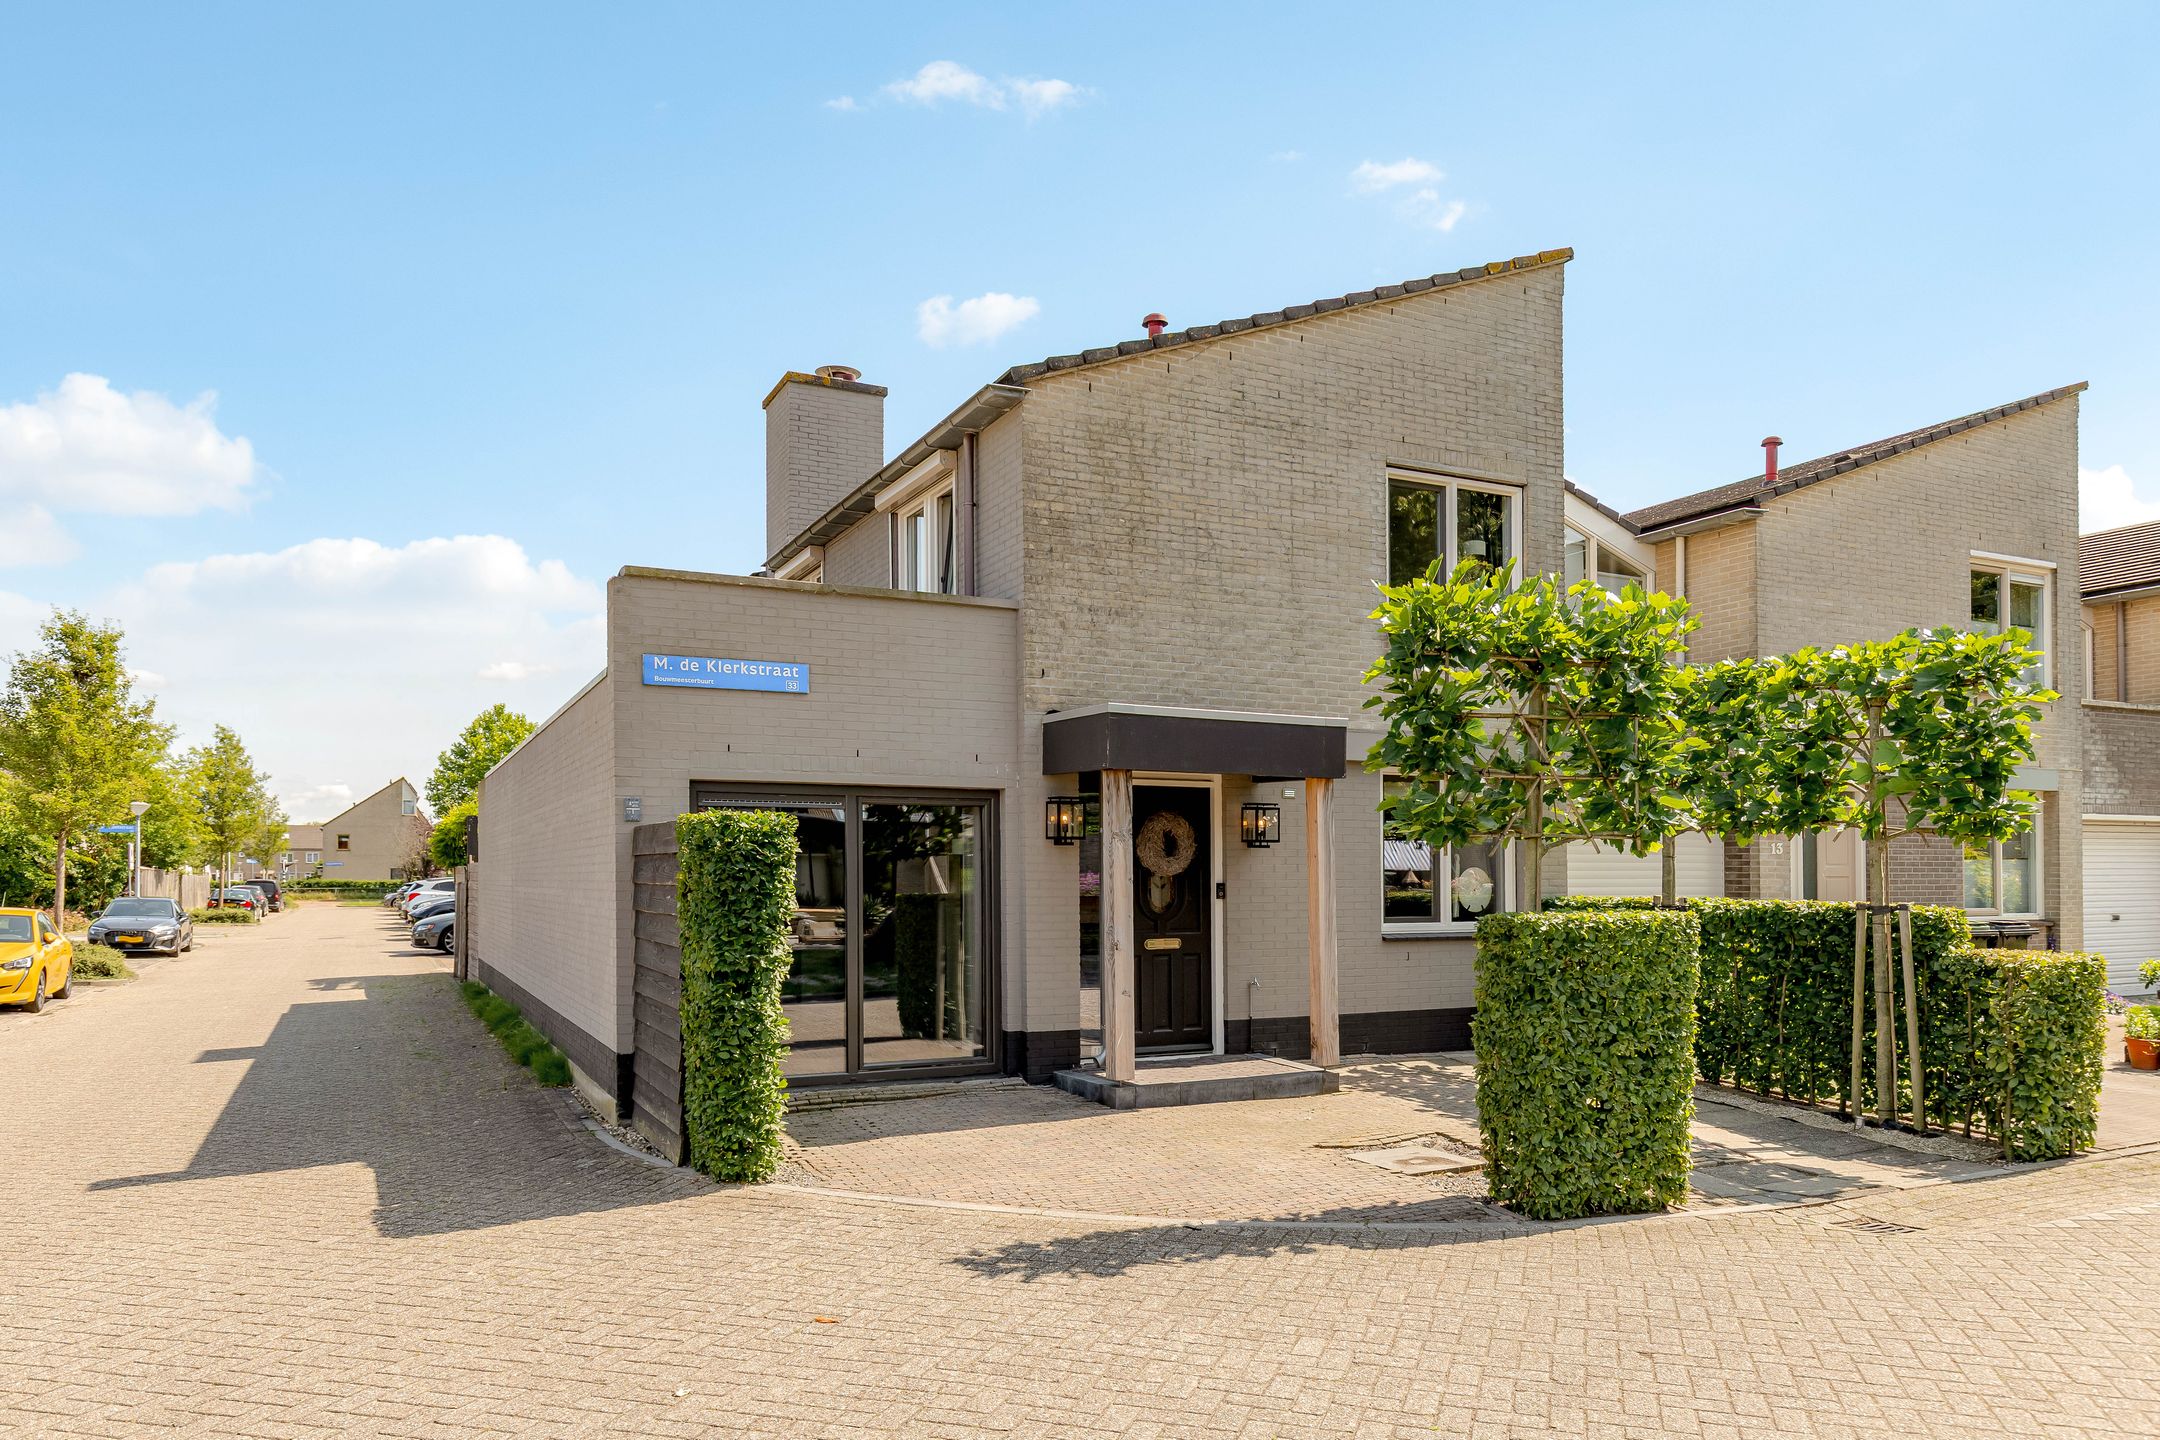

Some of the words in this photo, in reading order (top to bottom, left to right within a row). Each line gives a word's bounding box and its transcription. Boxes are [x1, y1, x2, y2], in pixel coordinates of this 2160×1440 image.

[653, 656, 673, 670] M.
[680, 659, 699, 672] de
[706, 660, 799, 678] Klerkstraat
[787, 682, 797, 690] 33
[1770, 842, 1784, 855] 13
